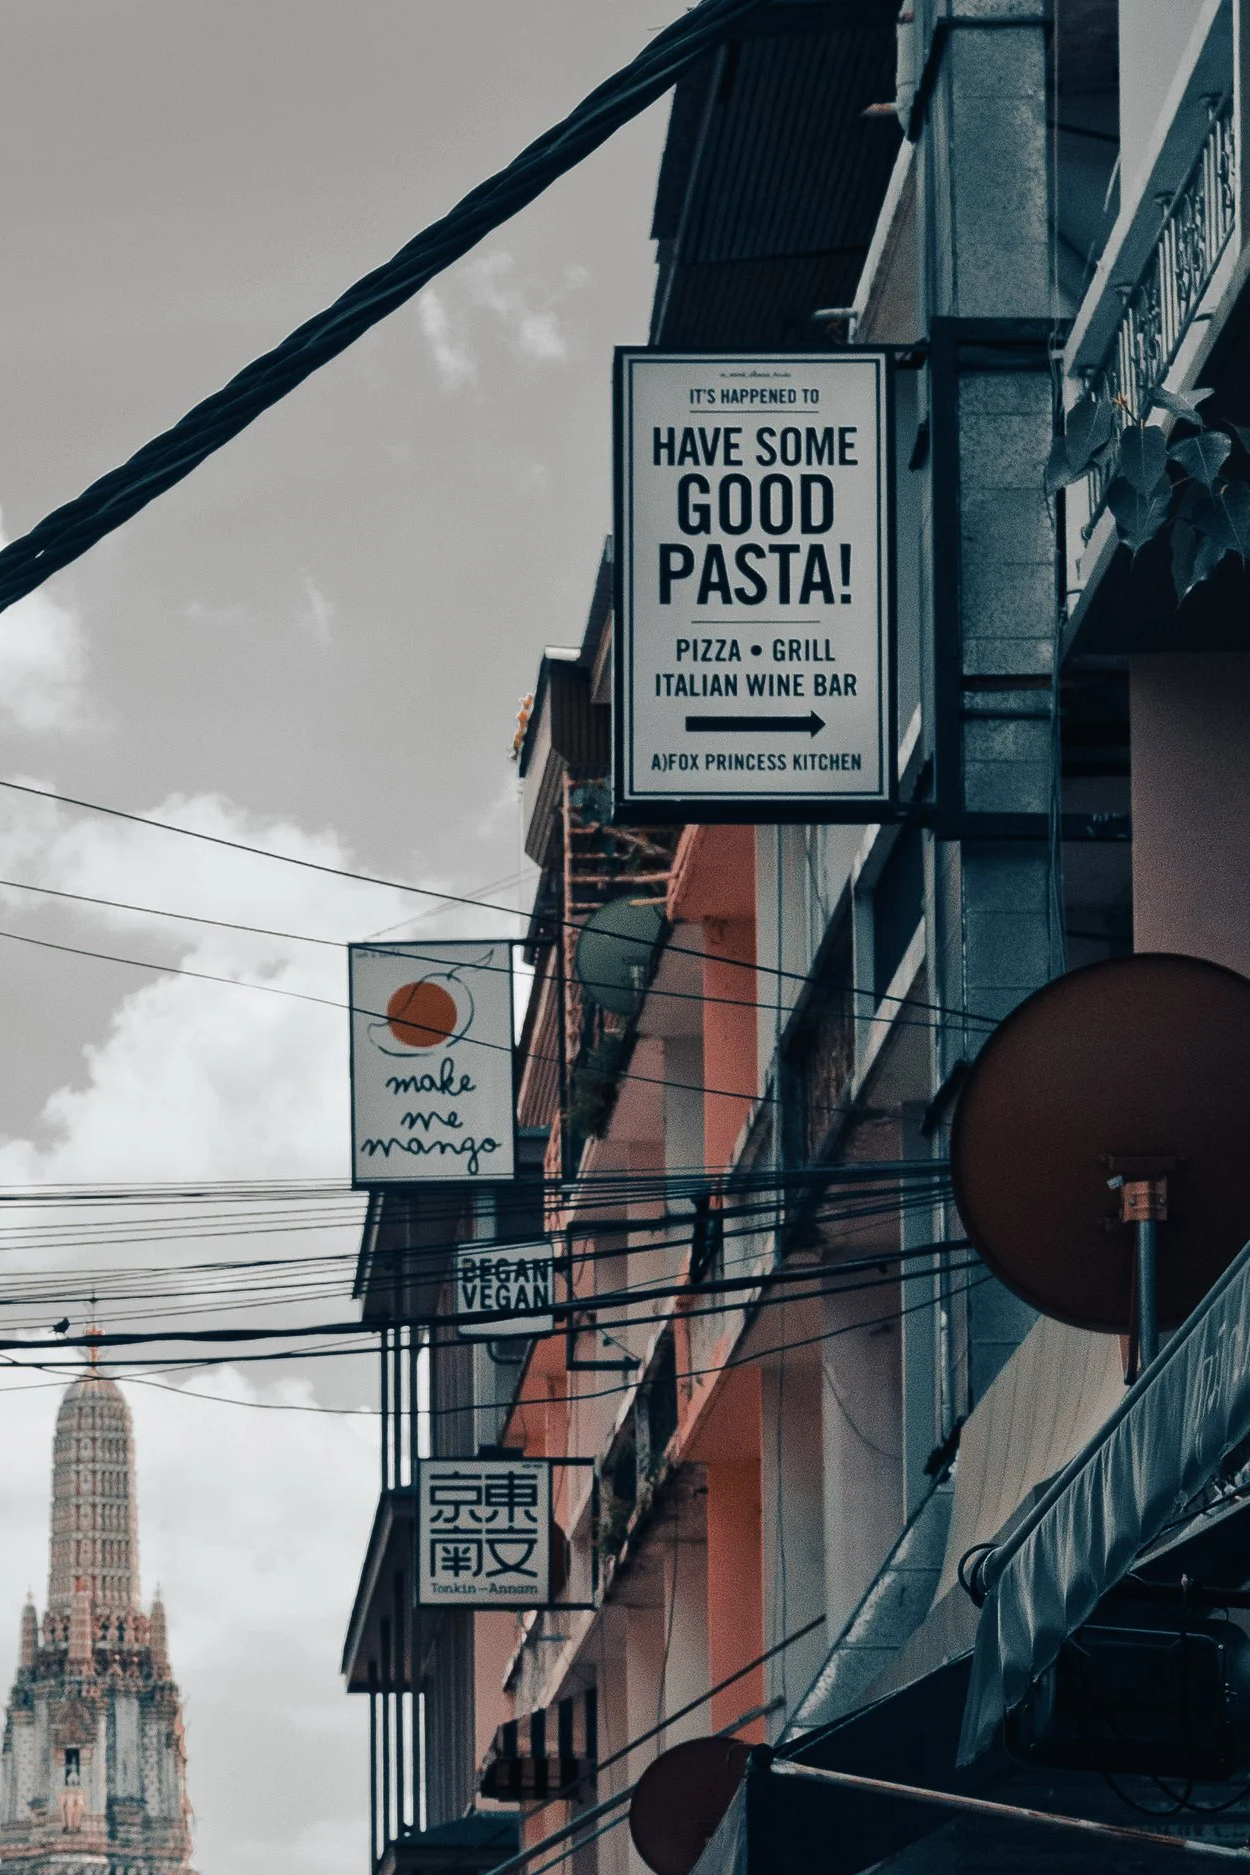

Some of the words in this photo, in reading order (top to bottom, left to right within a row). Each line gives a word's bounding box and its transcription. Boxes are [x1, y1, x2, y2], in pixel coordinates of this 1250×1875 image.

[690, 389, 716, 404] IT'S
[721, 389, 796, 404] HAPPENED
[802, 389, 820, 404] TO
[652, 426, 743, 467] HAVE
[756, 426, 859, 467] SOME
[678, 473, 834, 535] GOOD
[658, 543, 852, 606] PASTA!
[676, 638, 741, 662] PIZZA
[772, 638, 836, 662] GRILL
[655, 673, 738, 697] ITALIAN
[745, 673, 804, 697] WINE
[814, 673, 857, 697] BAR
[705, 754, 787, 771] PRINCESS
[793, 754, 861, 771] KITCHEN
[386, 1058, 476, 1096] make
[401, 1108, 463, 1130] me
[361, 1134, 502, 1174] mango
[462, 1284, 548, 1309] VEGAN
